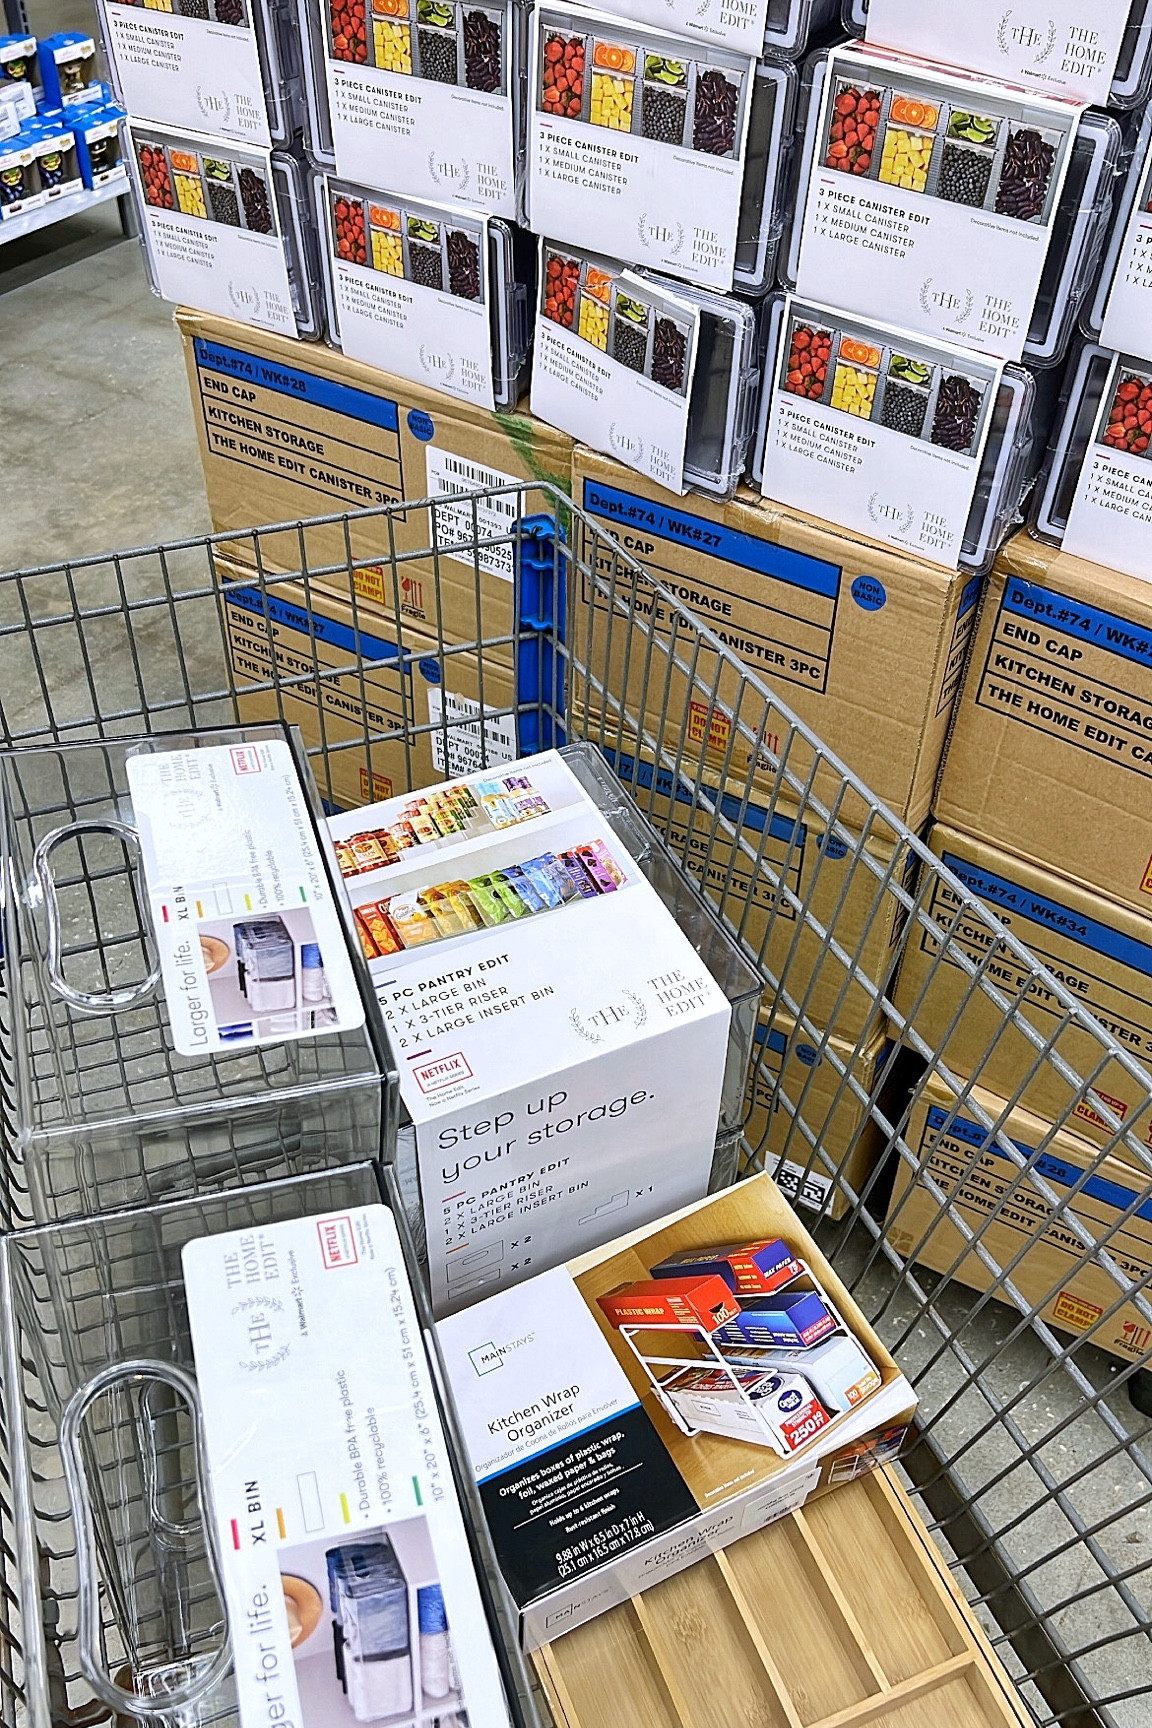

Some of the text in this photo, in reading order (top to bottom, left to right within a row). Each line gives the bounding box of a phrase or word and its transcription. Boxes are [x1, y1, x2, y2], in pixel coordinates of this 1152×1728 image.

[1064, 43, 1106, 64] HOME
[1070, 26, 1099, 44] THE
[342, 80, 363, 91] PIECE
[366, 85, 403, 99] CANISTER
[406, 94, 422, 104] EDIT
[547, 133, 572, 146] PIECE
[575, 140, 617, 158] CANISTER
[619, 153, 639, 164] EDIT
[819, 187, 930, 225] 3 PIECE CANISTER EDIT
[833, 205, 862, 220] SMALL
[864, 213, 910, 233] CANISTER
[822, 215, 828, 223] X
[830, 217, 867, 234] MEDIUM
[869, 228, 915, 248] CANISTER
[828, 230, 859, 245] LARGE
[861, 239, 906, 259] CANISTER
[982, 308, 1020, 328] HOME
[985, 295, 1013, 313] THE
[204, 376, 256, 402] END CAP
[262, 368, 306, 393] WK#28
[208, 406, 325, 455] KITCHEN STORAGE
[787, 409, 811, 424] PIECE
[814, 420, 855, 440] CANISTER
[856, 435, 876, 448] EDIT
[212, 433, 236, 450] THE
[240, 442, 275, 463] HOME
[278, 457, 306, 474] EDIT
[310, 468, 372, 500] CANISTER
[590, 492, 722, 548] Dept.#74 WK#27
[624, 536, 655, 555] CAP
[853, 590, 883, 606] BASIC
[858, 581, 880, 595] NON
[231, 611, 254, 627] END
[1011, 590, 1091, 632] Dept.#74
[1003, 622, 1083, 661] END CAP
[236, 655, 259, 672] THE
[789, 658, 822, 680] 3PC
[994, 654, 1076, 697] KITCHEN
[988, 683, 1128, 752] THE HOME EDIT
[173, 885, 190, 921] XL BIN
[1030, 902, 1088, 937] WK#34
[175, 939, 209, 1048] Larger for life.
[392, 987, 414, 1002] PC
[417, 967, 473, 992] PANTRY
[478, 954, 511, 973] EDIT
[647, 969, 686, 991] THE
[656, 977, 709, 1004] HOME
[385, 978, 487, 1020] 2 X LARGE BIN
[392, 986, 509, 1033] 1 X 3-TIER RISER
[399, 985, 555, 1048] 2 X LARGE INSERT BIN
[420, 1059, 462, 1081] NETFLIX
[438, 1090, 568, 1151] Step up
[441, 1089, 655, 1185] your storage.
[456, 1196, 476, 1210] PC
[481, 1172, 535, 1198] PANTRY
[540, 1156, 571, 1175] EDIT
[444, 1180, 540, 1226] 2 X LARGE BIN
[445, 1180, 590, 1246] 2 X LARGE INSERT BIN
[457, 1222, 466, 1230] X
[470, 1202, 511, 1224] 3-TIER
[516, 1184, 554, 1204] RISER
[240, 1235, 262, 1285] HOME
[325, 1225, 342, 1262] NETFLIX
[224, 1252, 242, 1289] THE
[296, 1298, 307, 1330] Walmart
[614, 1307, 665, 1316] PLASTIC WRAP
[712, 1308, 731, 1325] 100
[337, 1369, 353, 1407] plastic
[487, 1385, 580, 1435] Kitchen Wrap
[507, 1403, 574, 1442] Organizer
[347, 1435, 361, 1460] BPA
[475, 1398, 618, 1473] Organizador de Cocina de Rollos para Envolver
[789, 1420, 817, 1445] 250
[365, 1406, 393, 1506] 100% recyclable
[499, 1431, 625, 1497] Organizes boxes of plastic wrap,
[518, 1446, 616, 1499] foil, waxed paper & bags
[352, 1461, 371, 1511] Durable
[244, 1479, 267, 1545] XL BIN
[247, 1584, 280, 1683] for life.
